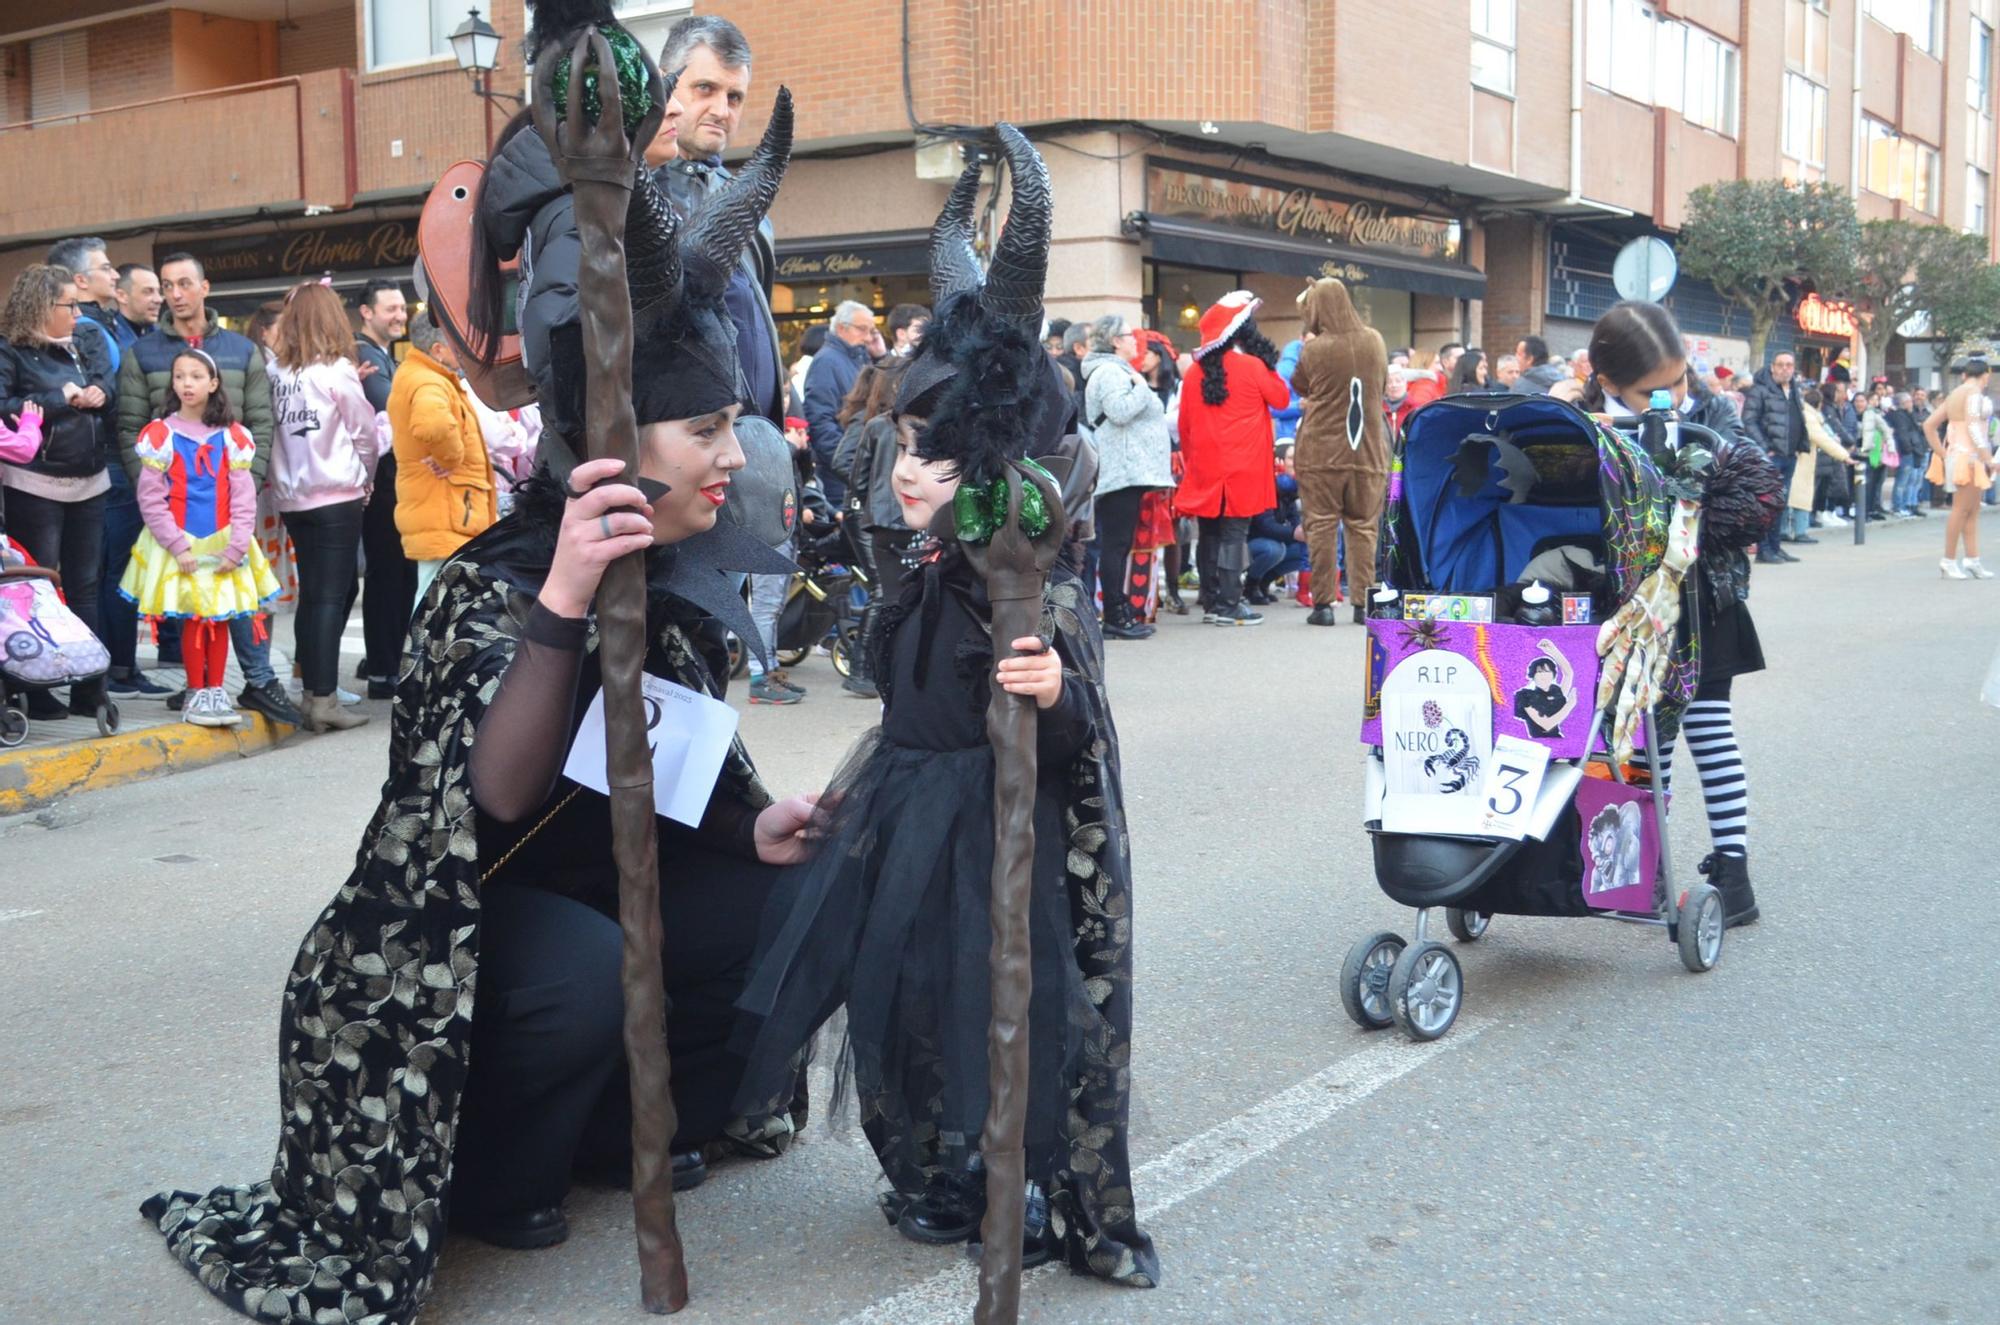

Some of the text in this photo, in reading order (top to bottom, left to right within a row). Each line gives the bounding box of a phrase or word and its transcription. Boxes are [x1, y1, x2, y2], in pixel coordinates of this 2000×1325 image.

[1276, 188, 1342, 236] Gloria
[282, 229, 364, 273] Gloria
[1395, 731, 1439, 752] NERO
[1488, 763, 1530, 815] 3
